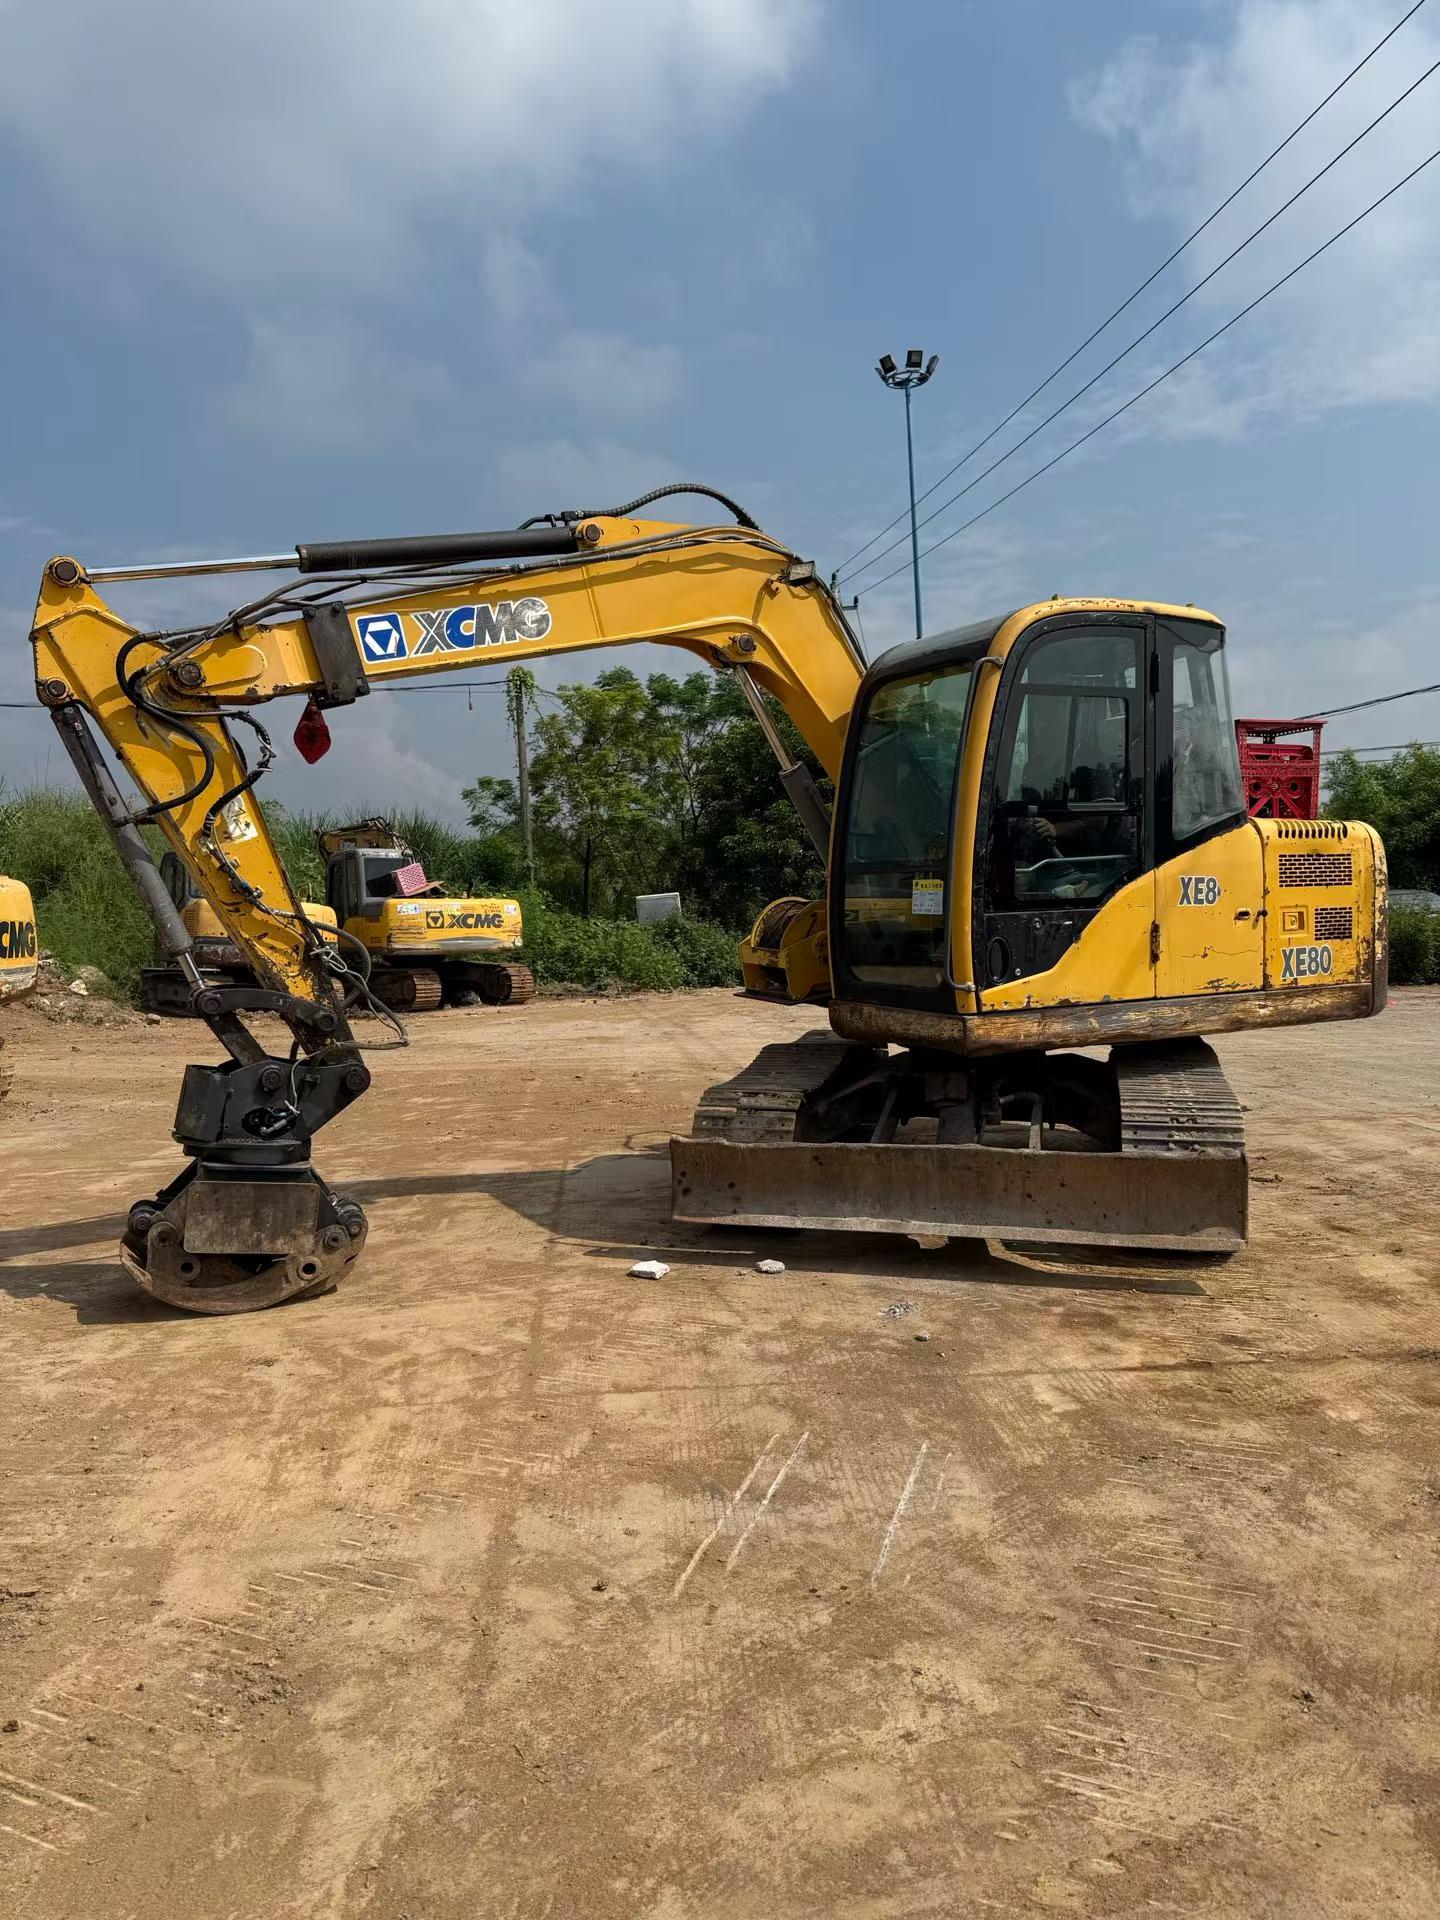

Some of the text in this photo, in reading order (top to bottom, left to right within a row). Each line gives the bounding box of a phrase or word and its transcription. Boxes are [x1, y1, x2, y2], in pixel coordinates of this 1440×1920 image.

[411, 598, 551, 656] XCMG
[1178, 876, 1221, 906] XE8
[445, 913, 504, 929] XCMG
[1281, 945, 1332, 979] XE80
